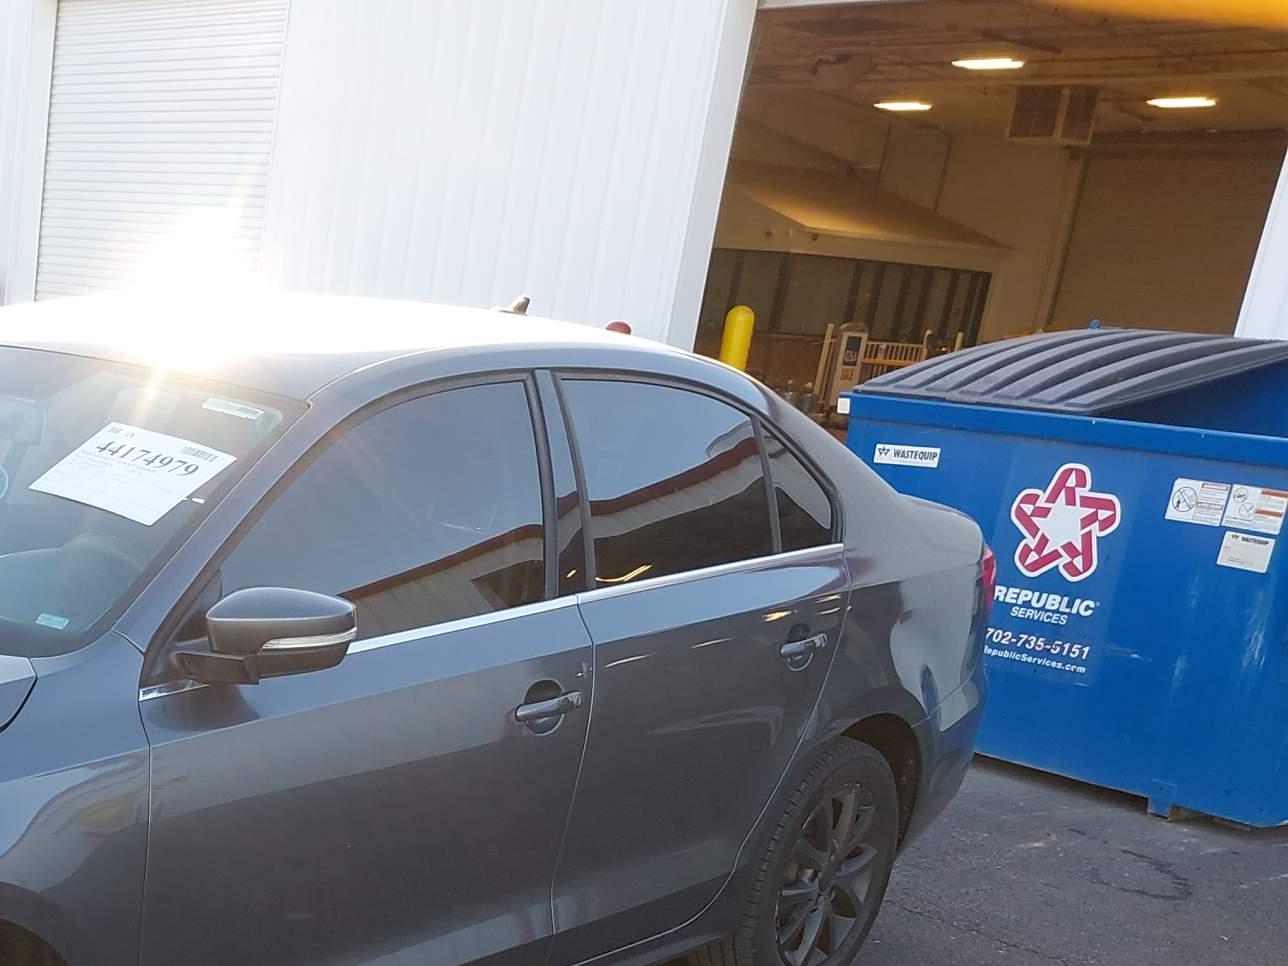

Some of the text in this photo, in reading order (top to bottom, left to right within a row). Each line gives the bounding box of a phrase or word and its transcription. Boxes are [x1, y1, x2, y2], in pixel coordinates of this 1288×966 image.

[95, 440, 200, 477] 44174979
[893, 447, 938, 461] WASTEQUIP
[993, 585, 1096, 617] REPUBLIC
[1010, 606, 1068, 625] SERVICES
[985, 627, 1091, 660] 702-735-5151
